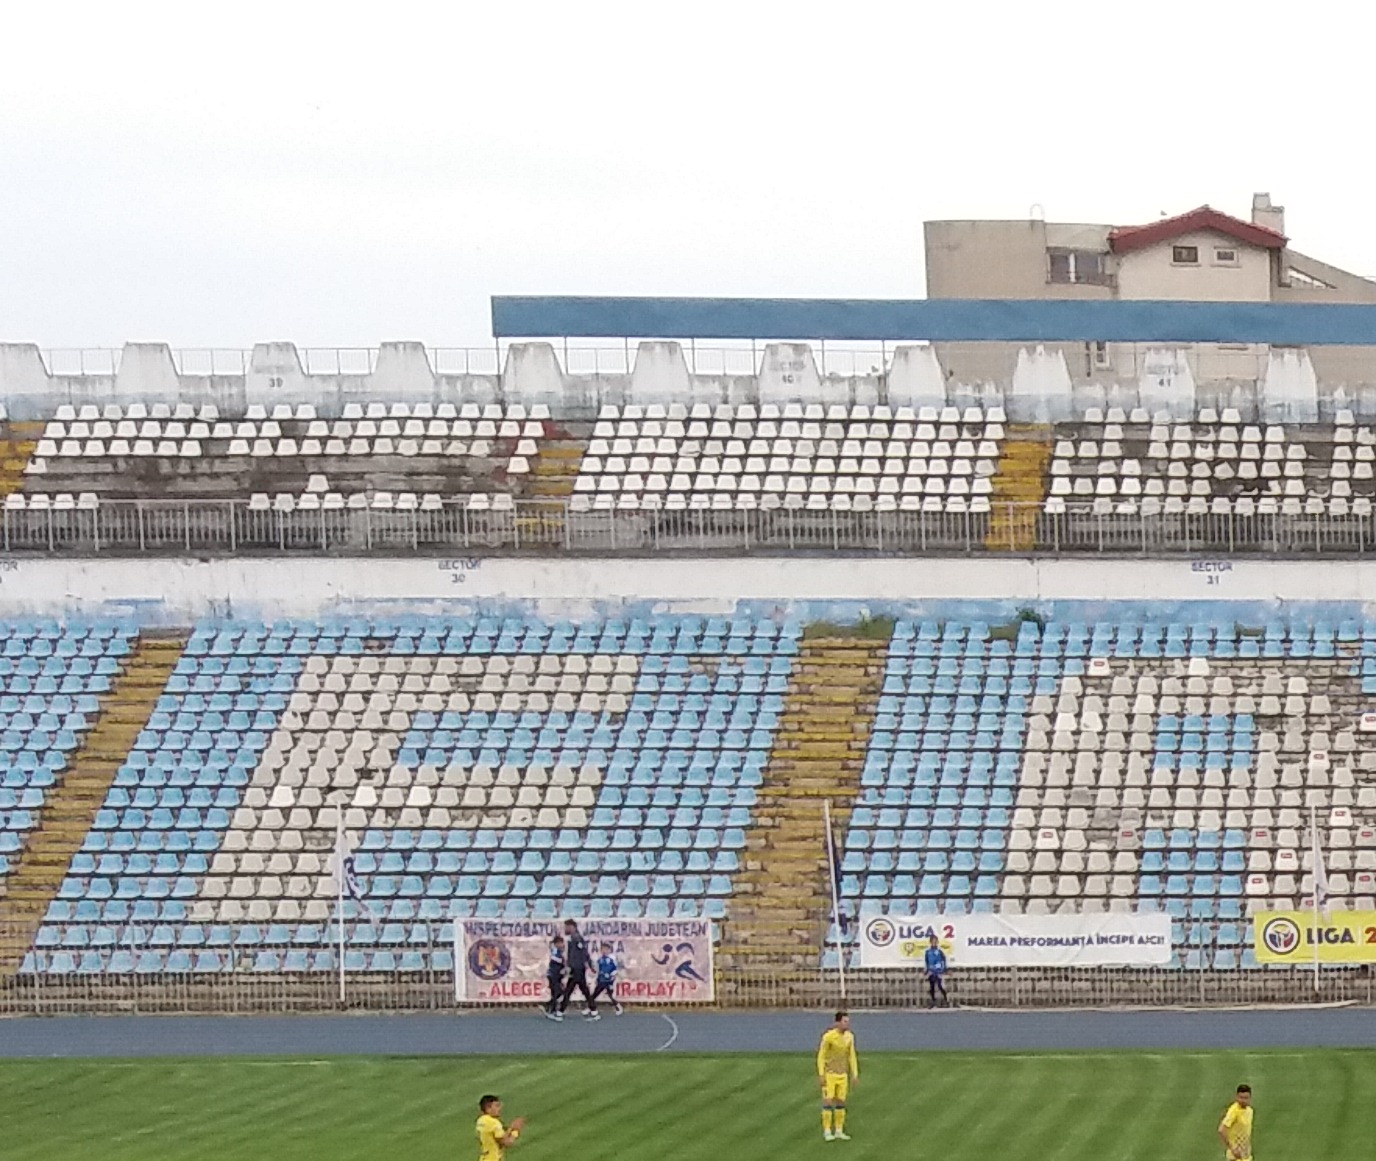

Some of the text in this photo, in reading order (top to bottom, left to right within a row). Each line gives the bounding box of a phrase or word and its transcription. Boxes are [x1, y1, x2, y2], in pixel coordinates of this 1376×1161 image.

[900, 925, 955, 939] LIGA 2
[1306, 927, 1355, 944] LIGA
[491, 982, 541, 996] ALEGE
